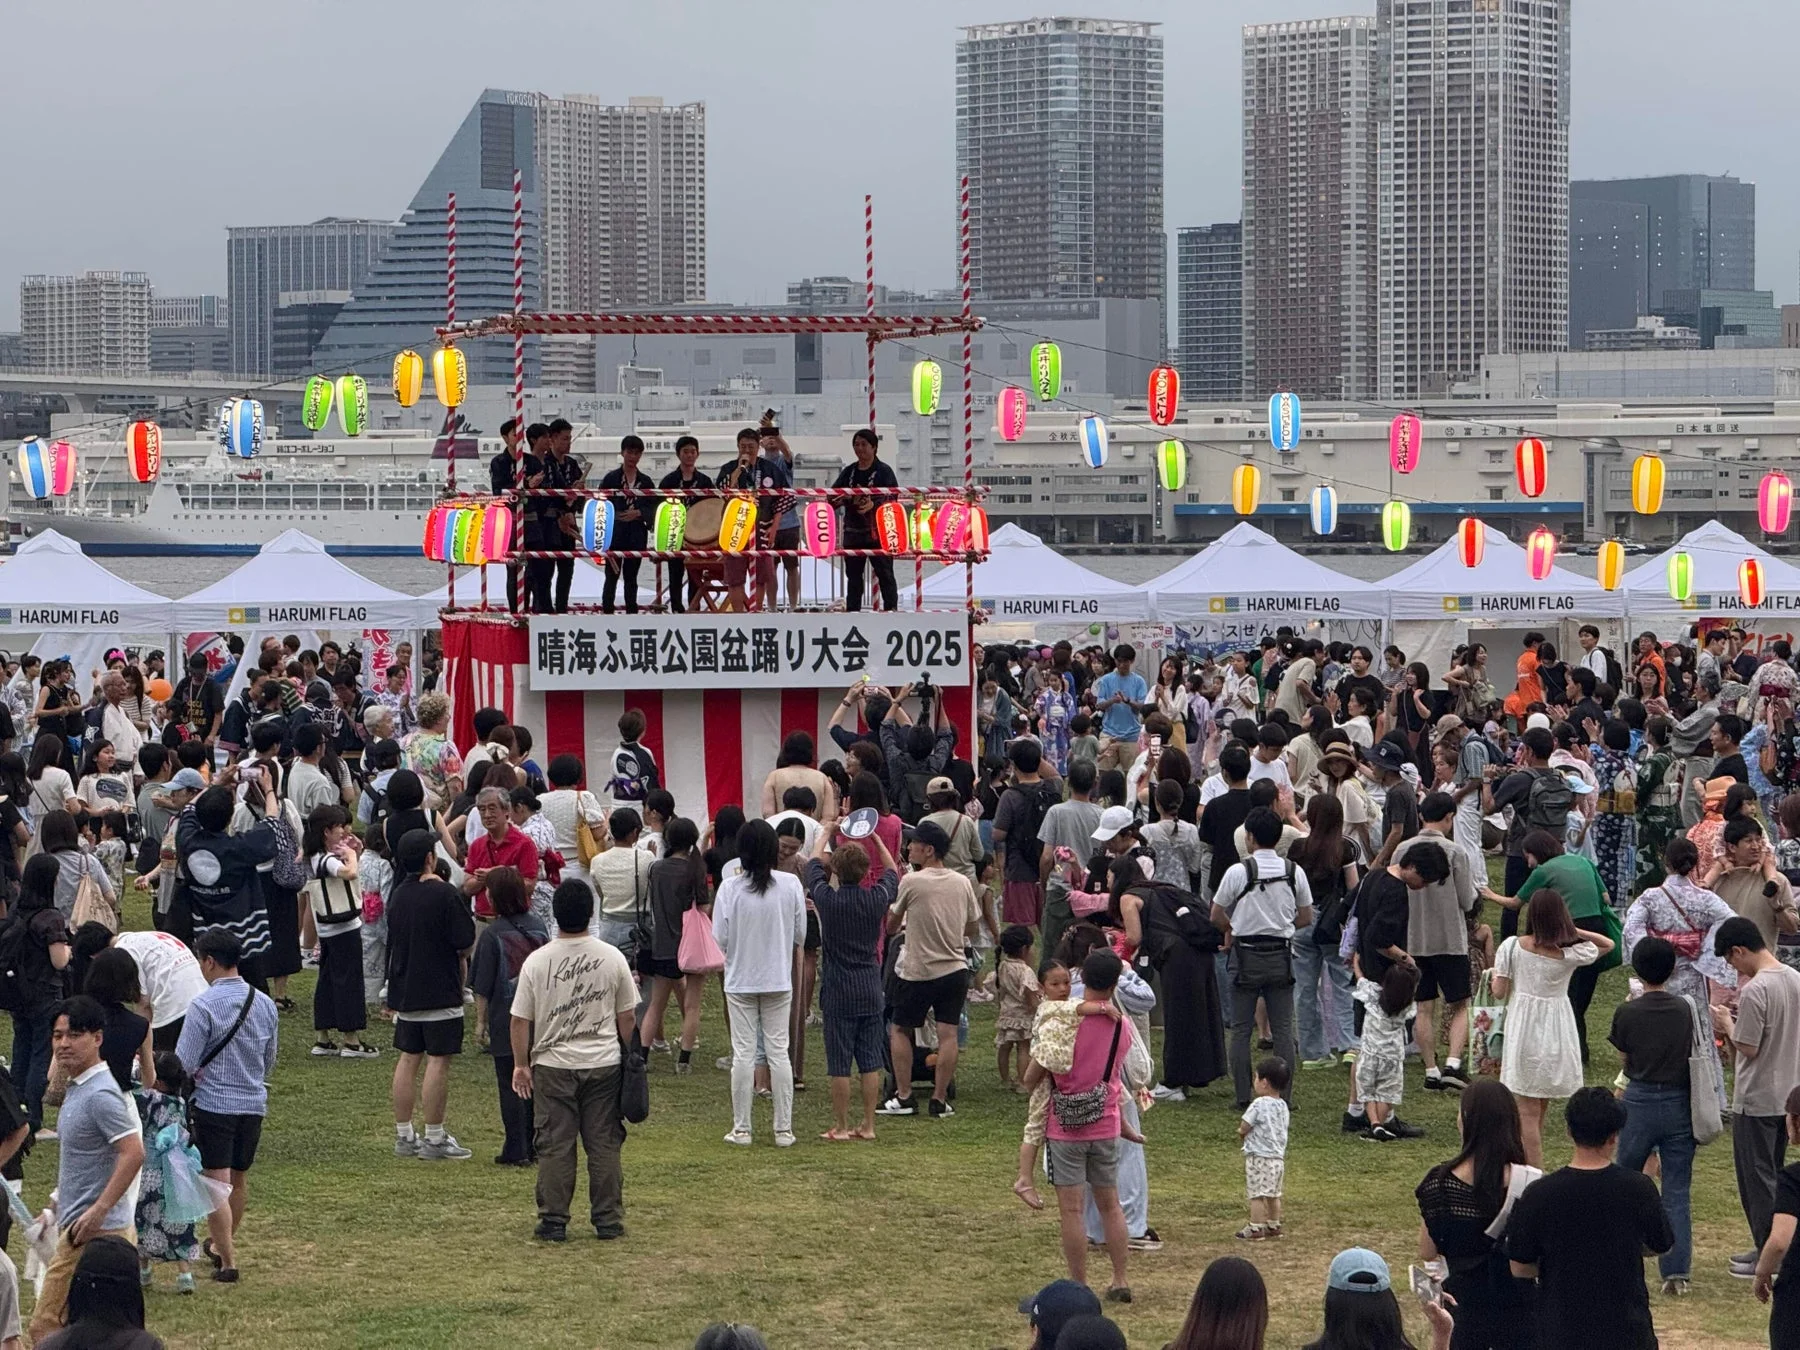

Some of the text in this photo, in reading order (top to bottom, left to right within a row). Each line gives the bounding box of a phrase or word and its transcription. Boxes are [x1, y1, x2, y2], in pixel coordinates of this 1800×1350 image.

[1037, 348, 1050, 395] 三井のリハウス
[1014, 392, 1025, 436] 三井のリハウス
[252, 404, 261, 456] PLANETS
[1676, 423, 1740, 433] 日本塩回送
[816, 509, 829, 542] CCC
[1003, 600, 1098, 614] HARUMI FLAG
[1247, 597, 1340, 611] HARUMI FLAG
[1481, 596, 1574, 610] HARUMI FLAG
[1719, 596, 1772, 609] HARMI
[20, 610, 119, 624] HARUMI FLAG
[268, 607, 367, 621] HARUMI FLAG
[1193, 624, 1305, 637] ソースせんい
[537, 626, 962, 675] 晴海ふ頭公園盆踊り大会 2025
[554, 954, 605, 988] Rather
